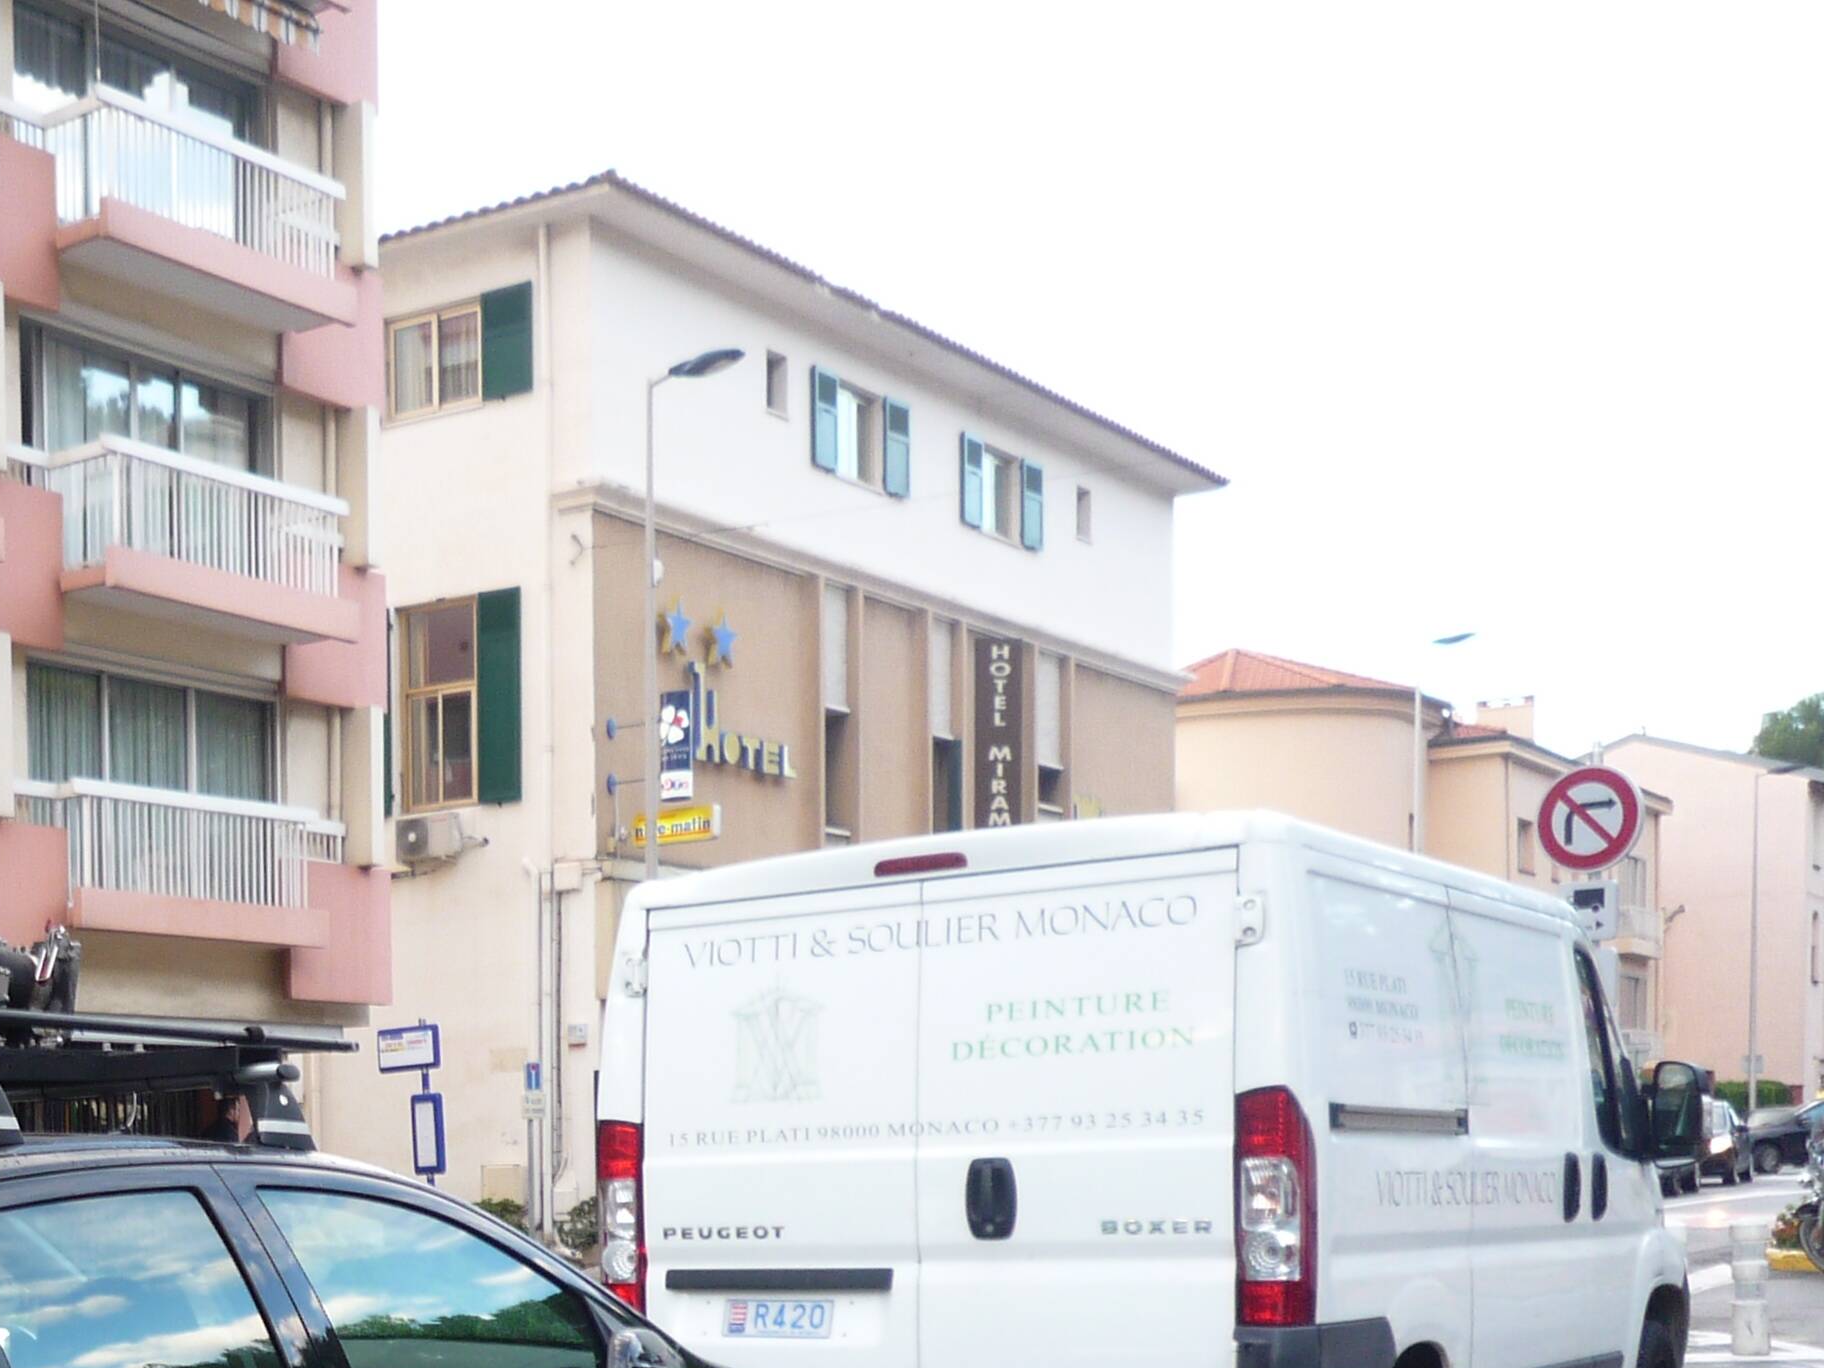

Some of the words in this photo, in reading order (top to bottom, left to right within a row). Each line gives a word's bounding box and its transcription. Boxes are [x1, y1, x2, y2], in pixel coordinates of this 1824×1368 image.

[989, 644, 1012, 727] HOTEL
[688, 661, 798, 779] HOTEL
[683, 932, 798, 969] VIOTTI
[809, 928, 836, 958] &
[847, 913, 1000, 955] SOULIER
[1015, 895, 1198, 938] MONACO
[986, 989, 1169, 1023] PEINTURE
[951, 1026, 1196, 1062] DÉCORATION
[669, 1132, 689, 1148] 15
[695, 1130, 740, 1147] RUE
[746, 1125, 811, 1144] PLATI
[817, 1122, 880, 1140] 98000
[887, 1117, 1000, 1138] MONACO
[1071, 1113, 1098, 1130] 93
[1104, 1112, 1132, 1129] 25
[1140, 1110, 1168, 1127] 34
[1177, 1108, 1206, 1125] 35
[662, 1225, 785, 1240] PEUGEOT
[1100, 1219, 1213, 1235] BOXER
[753, 1303, 826, 1329] R420
